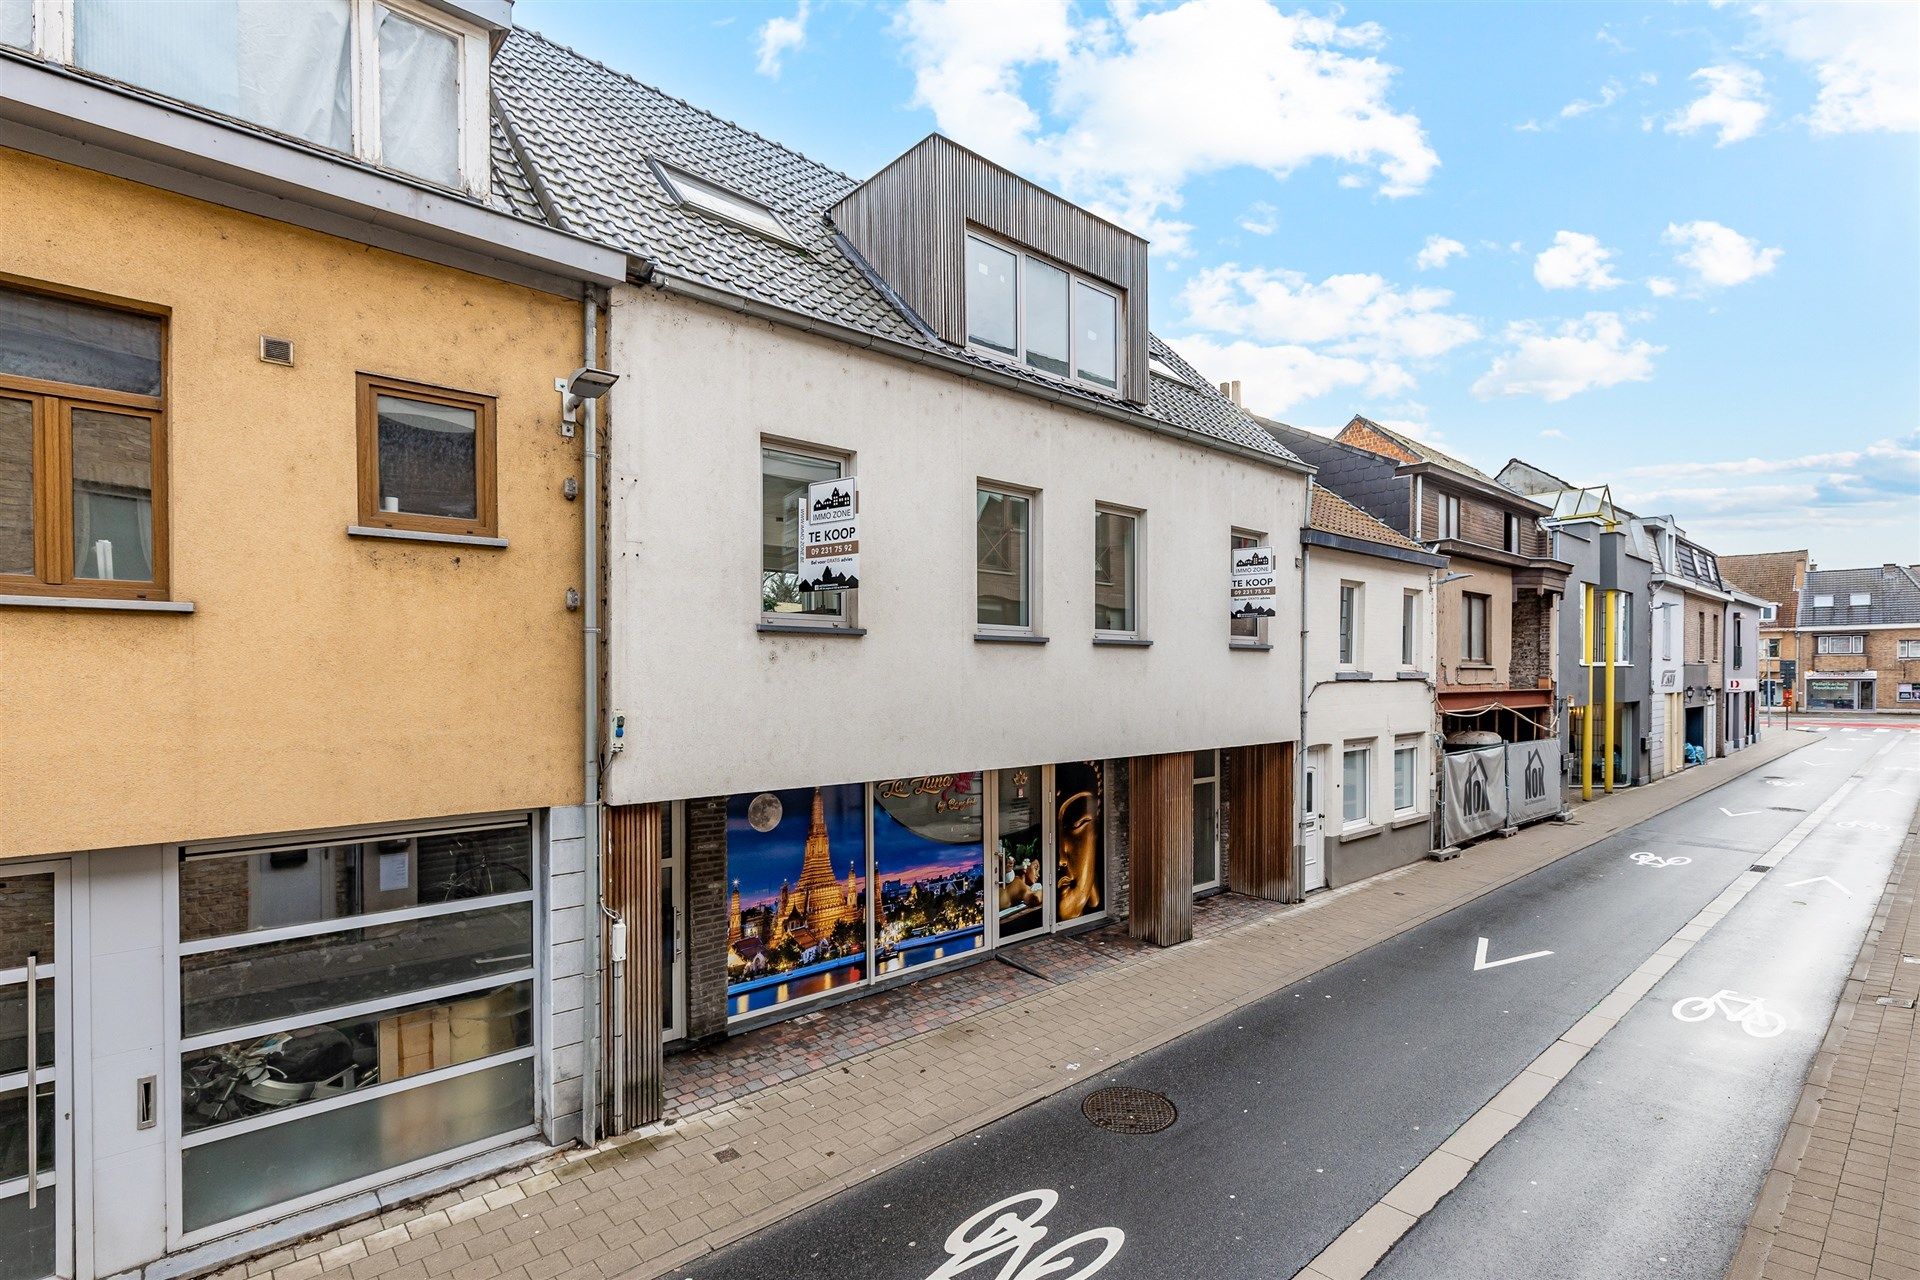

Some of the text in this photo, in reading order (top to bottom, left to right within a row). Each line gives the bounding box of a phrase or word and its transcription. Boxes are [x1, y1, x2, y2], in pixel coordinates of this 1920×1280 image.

[813, 509, 851, 521] IMMO ZONE
[808, 526, 856, 543] TE KOOP
[811, 544, 852, 556] 09 231 75 92
[1246, 578, 1273, 587] KOOP
[878, 776, 955, 798] La Luna
